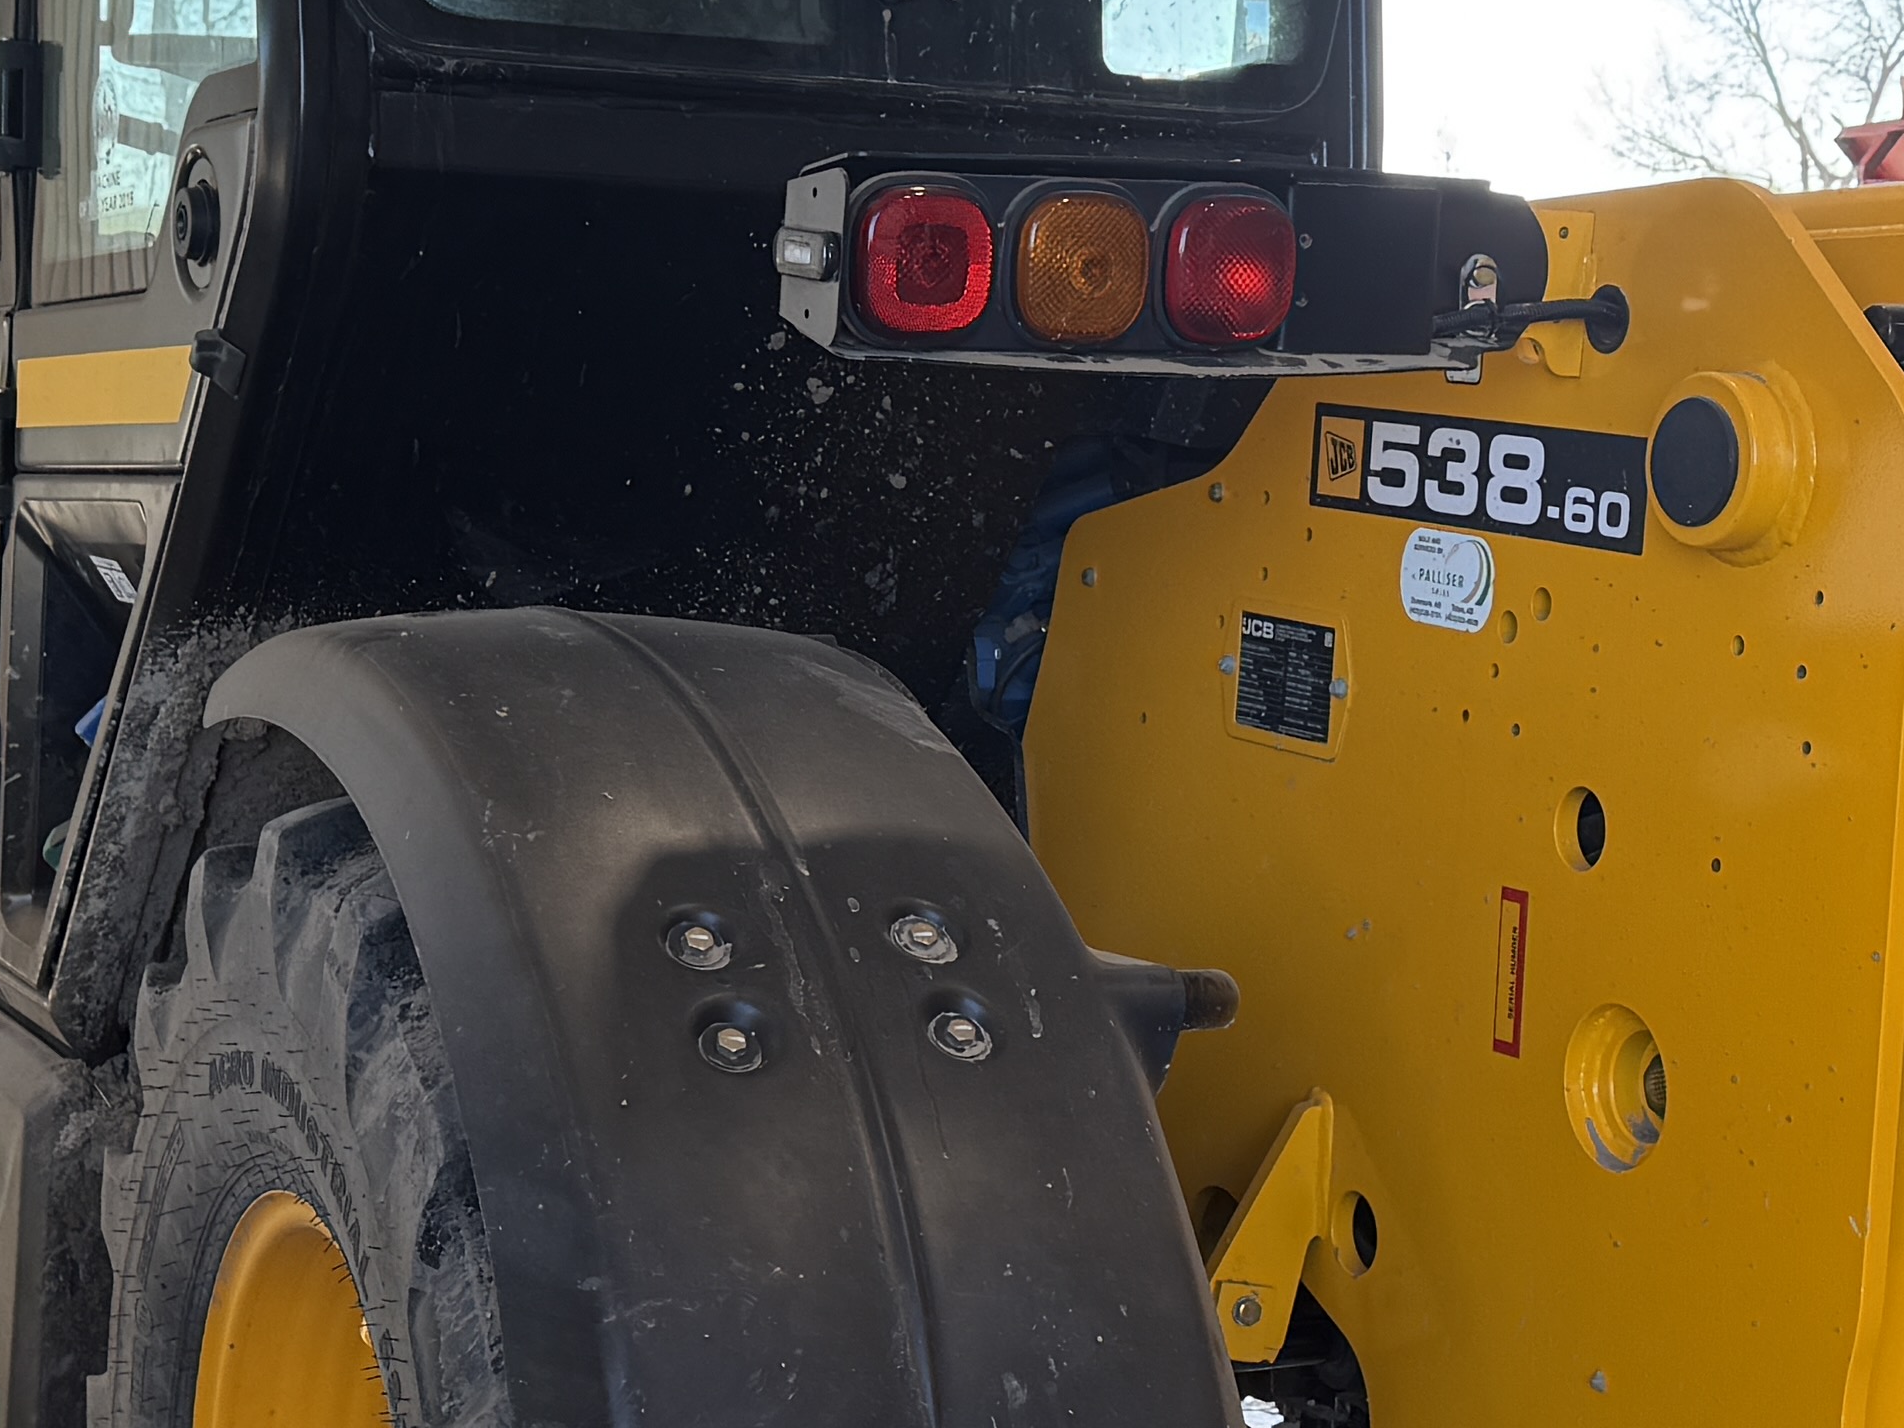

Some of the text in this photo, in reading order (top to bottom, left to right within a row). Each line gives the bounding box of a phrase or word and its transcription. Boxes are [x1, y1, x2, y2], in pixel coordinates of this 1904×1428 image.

[1329, 435, 1356, 477] JCB
[1242, 616, 1274, 639] JCB
[208, 1049, 255, 1100] AGRO
[260, 1055, 370, 1302] INDUSTRIAL
